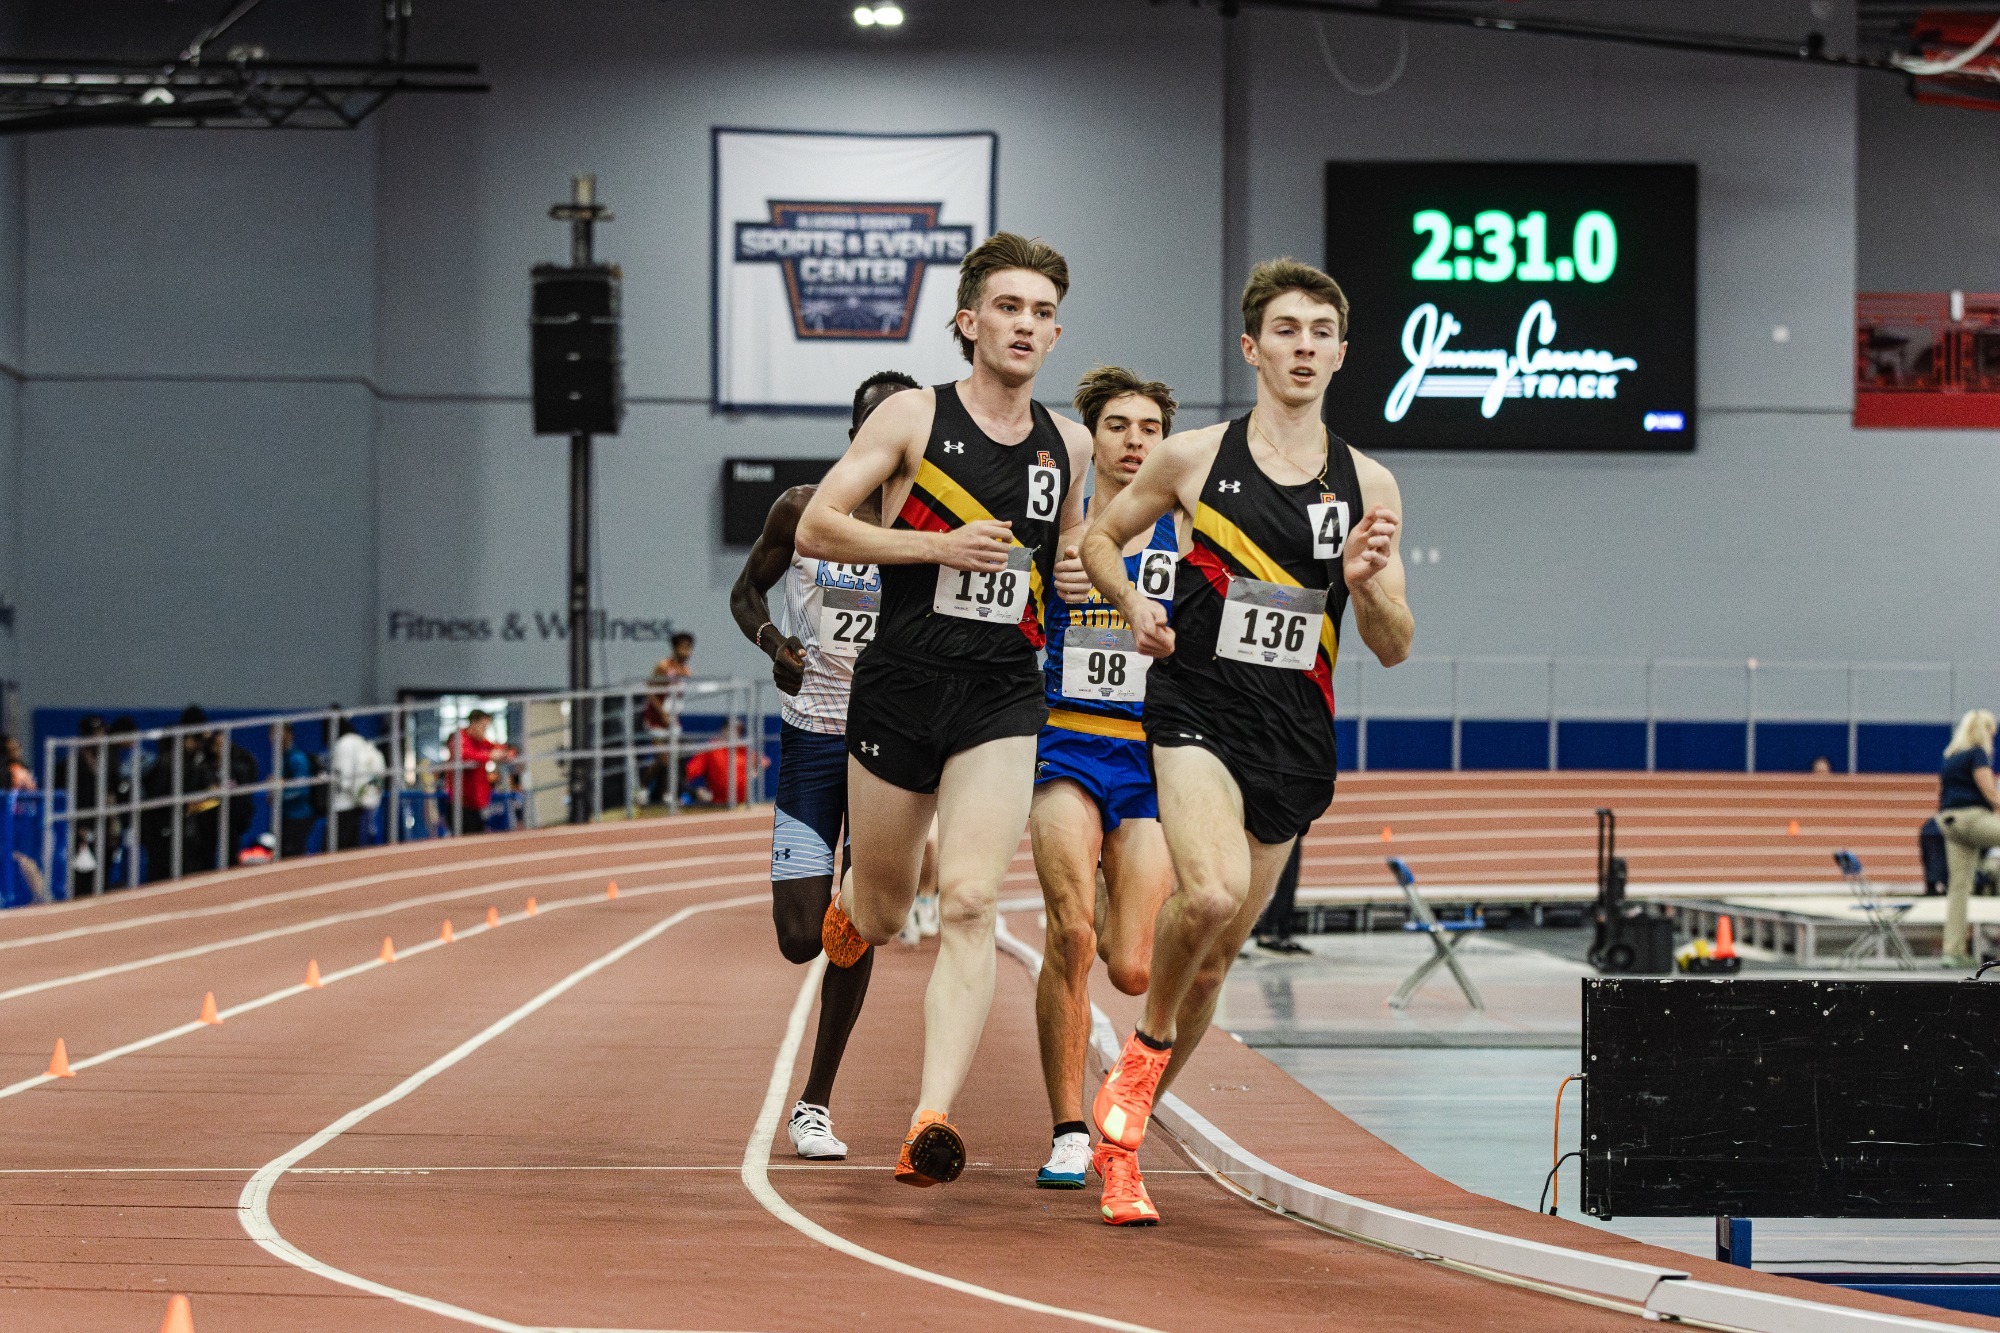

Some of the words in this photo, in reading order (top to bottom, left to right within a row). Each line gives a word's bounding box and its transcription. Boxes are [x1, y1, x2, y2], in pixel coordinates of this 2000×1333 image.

[740, 230, 844, 256] SPORTS
[864, 231, 967, 259] EVENTS
[1411, 208, 1618, 284] 2:31.0
[800, 259, 907, 283] CENTER
[1521, 374, 1619, 399] TRACK
[1033, 469, 1055, 517] 3
[1318, 506, 1343, 555] 4
[955, 571, 1017, 607] 138
[1143, 553, 1172, 595] 6
[389, 609, 492, 641] Fitness
[502, 611, 526, 641] &
[534, 609, 673, 642] Wllness
[833, 611, 880, 643] 22
[1070, 609, 1131, 630] RIDD
[1240, 608, 1308, 652] 136
[1087, 651, 1127, 686] 98
